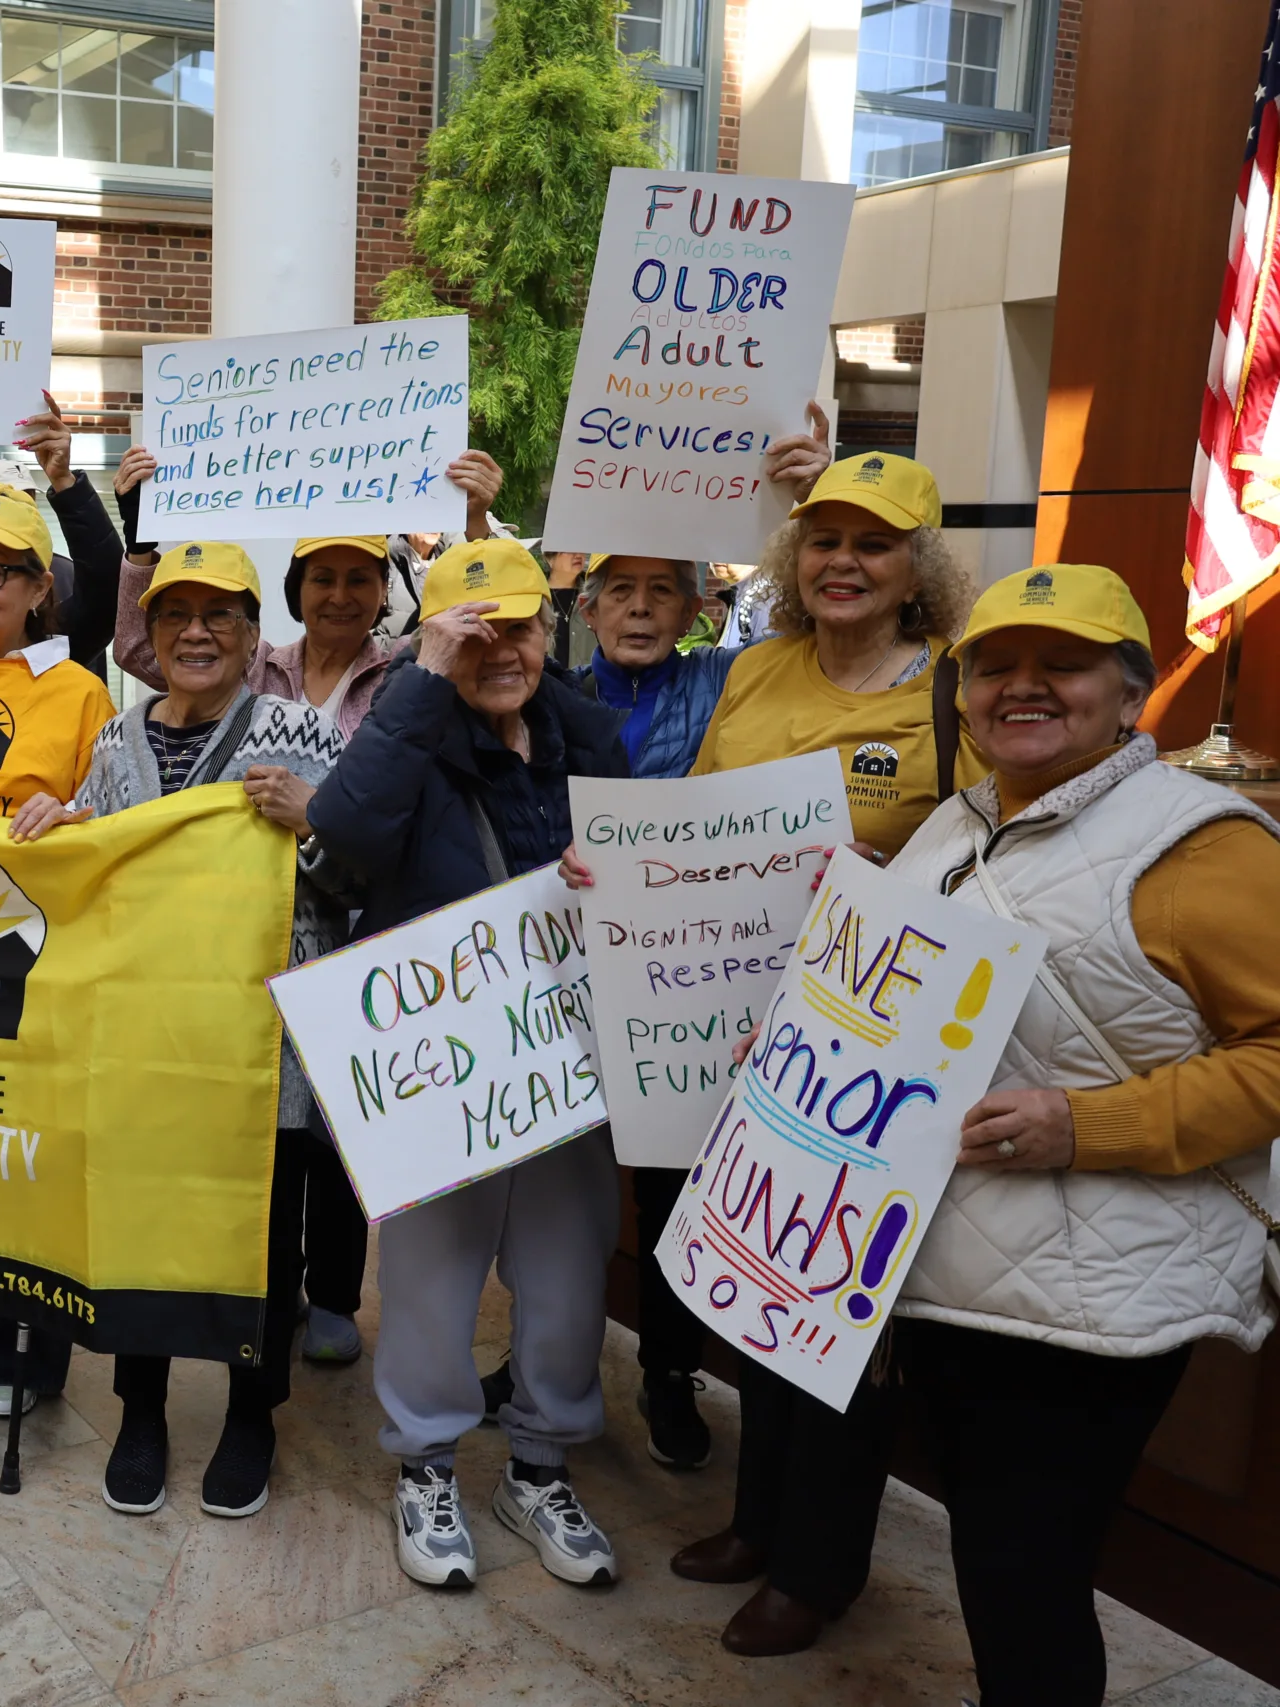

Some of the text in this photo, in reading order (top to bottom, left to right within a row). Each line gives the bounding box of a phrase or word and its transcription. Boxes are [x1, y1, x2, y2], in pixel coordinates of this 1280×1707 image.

[645, 184, 793, 237] FUND
[632, 258, 788, 314] OLDER
[155, 331, 440, 405] Seniors need the
[613, 324, 764, 368] Adult
[155, 375, 467, 448] funds for recreations
[605, 373, 749, 405] Mayores
[153, 424, 439, 484] and better support
[254, 478, 325, 509] help
[341, 473, 399, 505] us!
[845, 785, 901, 801] OMMUNITY
[849, 798, 886, 810] SERVICES
[850, 775, 893, 788] SUNNYSIDE
[782, 798, 836, 836] We
[361, 920, 510, 1033] OLDER
[804, 893, 947, 1022] SAVE
[351, 1034, 476, 1122] NEED
[752, 991, 938, 1149] Senior
[461, 1053, 600, 1157] MEALS
